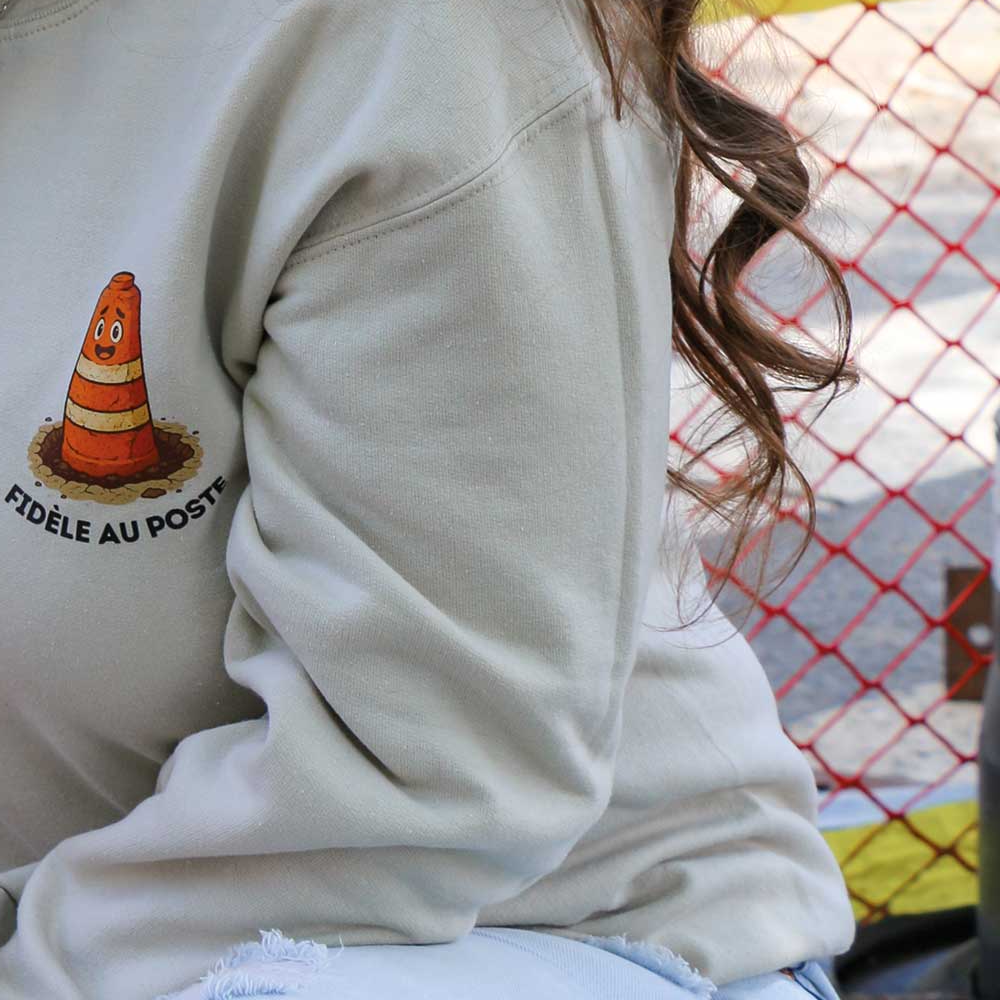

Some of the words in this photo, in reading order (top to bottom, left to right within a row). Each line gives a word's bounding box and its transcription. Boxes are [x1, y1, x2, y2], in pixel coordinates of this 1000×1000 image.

[4, 484, 91, 543] FIDÈLE
[98, 520, 140, 545] AU
[145, 475, 227, 538] POSTE
